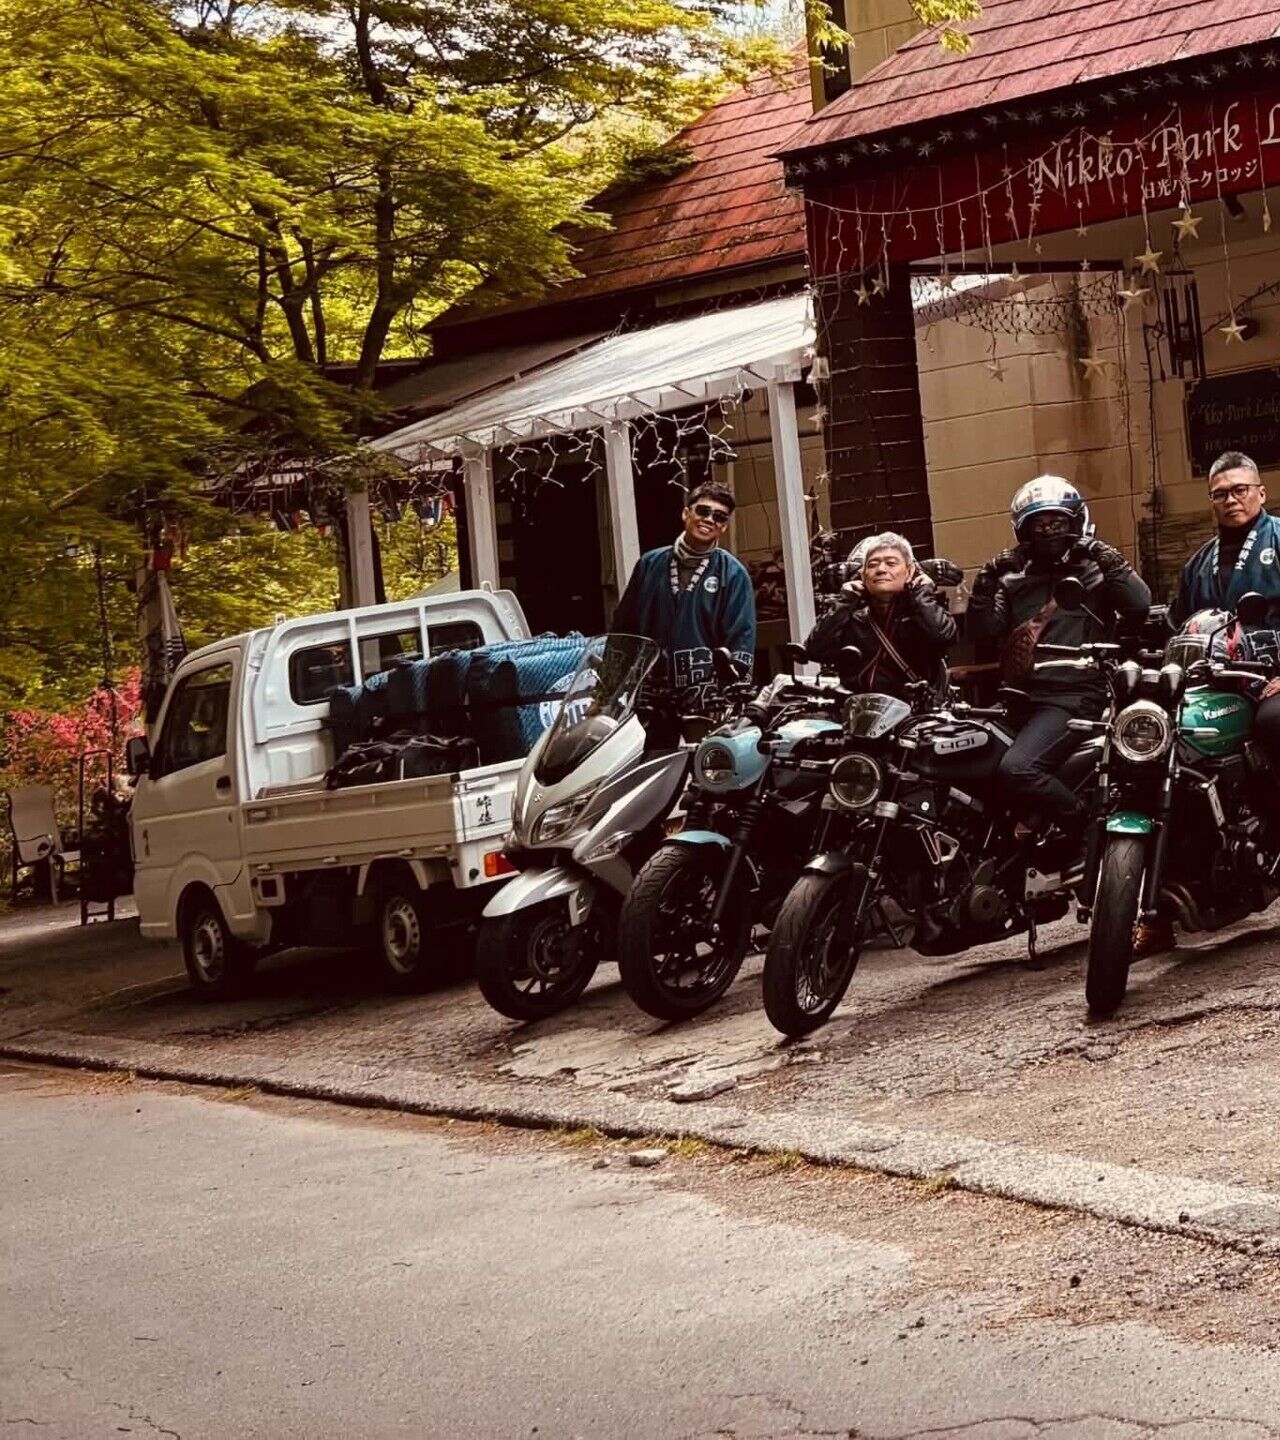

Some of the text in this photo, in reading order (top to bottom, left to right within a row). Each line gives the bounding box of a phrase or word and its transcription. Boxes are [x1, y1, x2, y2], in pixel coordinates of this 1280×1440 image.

[1030, 148, 1134, 193] Nikko
[1151, 101, 1243, 169] Park
[940, 737, 975, 749] 401
